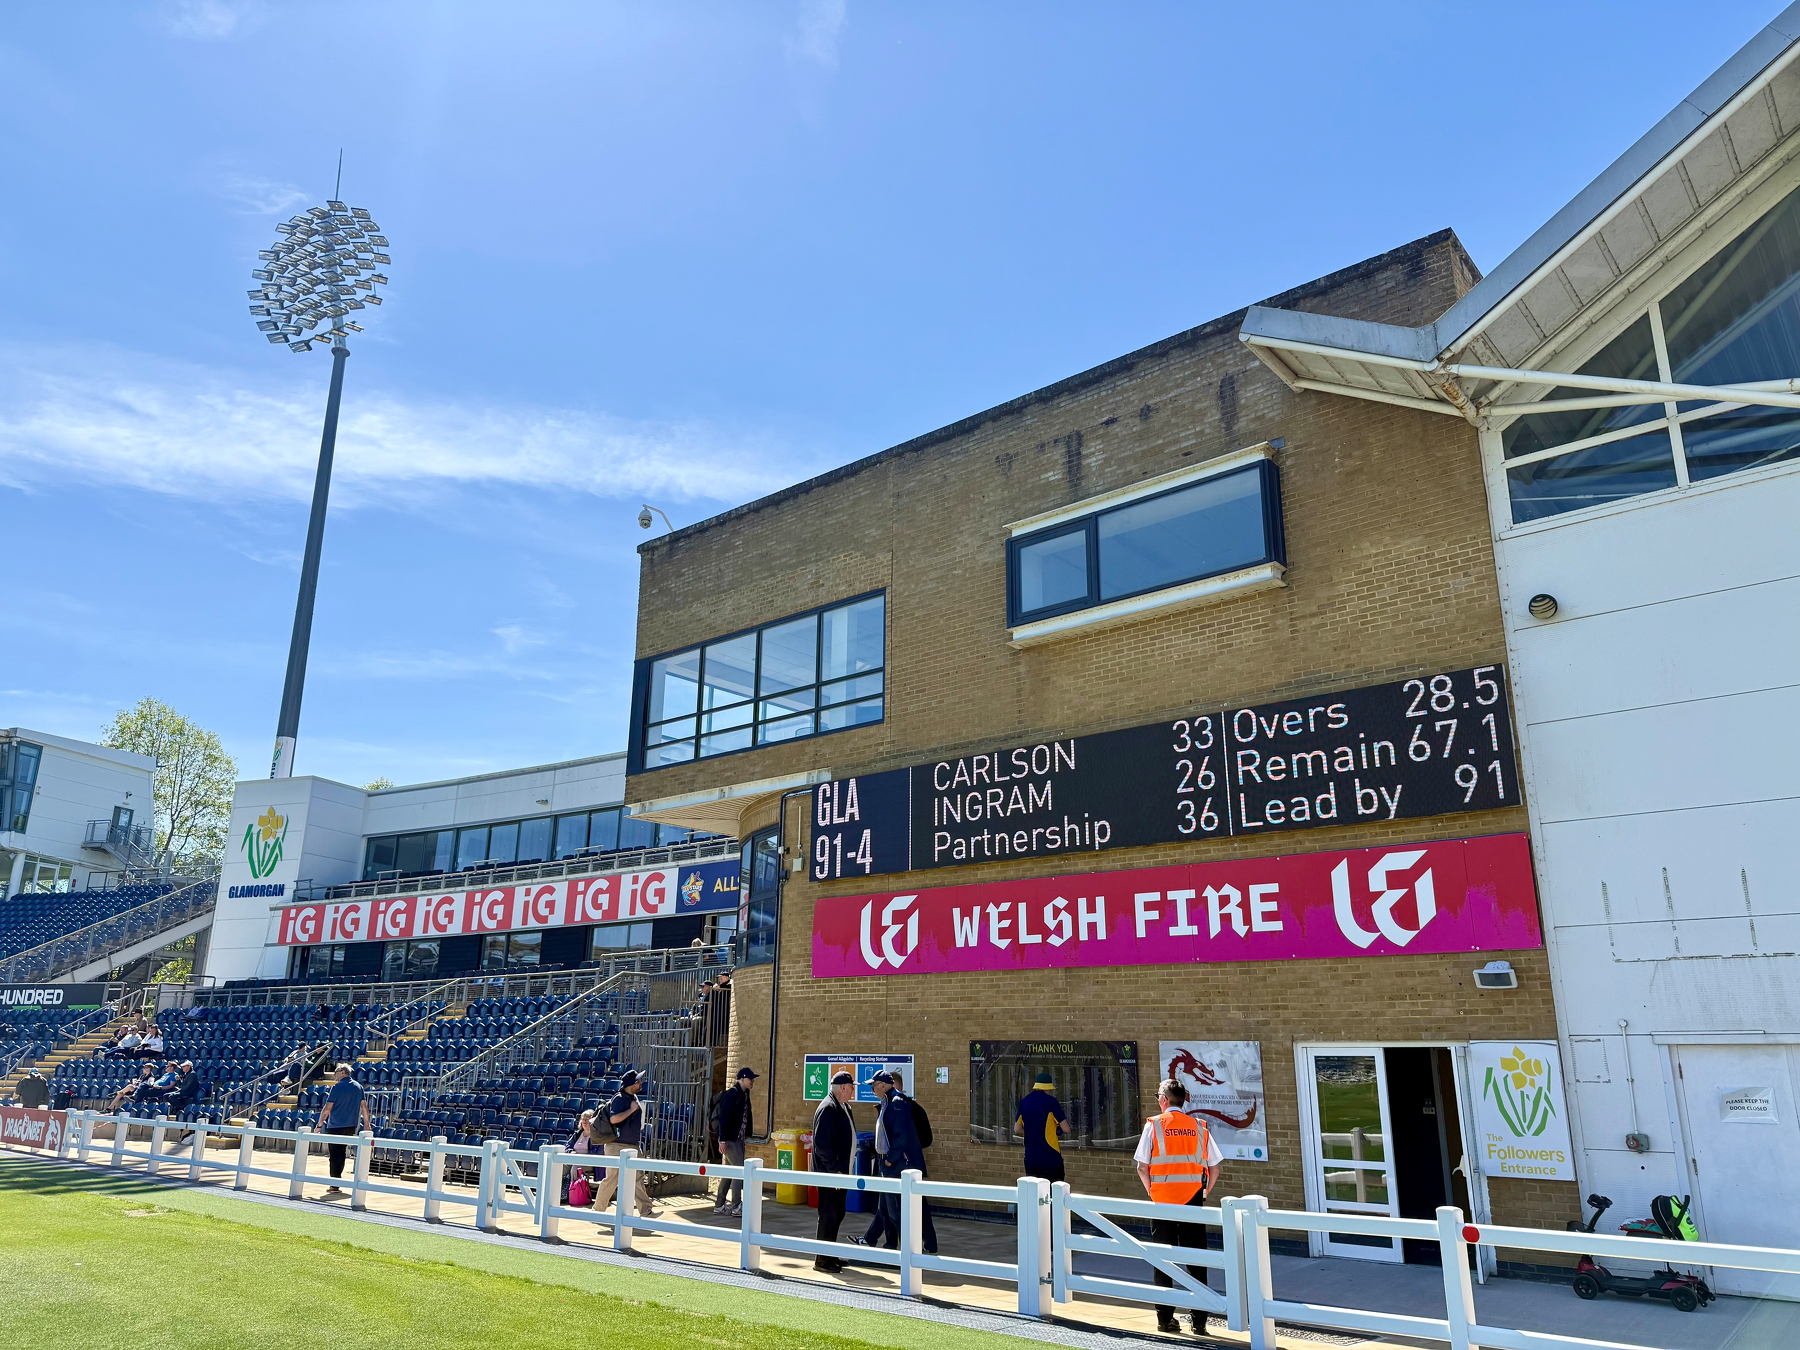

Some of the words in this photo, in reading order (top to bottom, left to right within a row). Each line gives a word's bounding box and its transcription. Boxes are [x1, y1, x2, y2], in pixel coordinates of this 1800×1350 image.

[1233, 703, 1349, 743] Overs
[1402, 666, 1499, 718] 28.5
[1172, 716, 1214, 753] 33
[1237, 732, 1396, 785] Remain
[1407, 713, 1499, 762] 67.1
[933, 739, 1075, 791] CARLSON
[1175, 756, 1216, 794] 26
[817, 778, 860, 827] GLA
[934, 780, 1053, 827] INGRAM
[1240, 782, 1337, 828] Lead
[1355, 778, 1402, 820] by
[1454, 759, 1505, 804] 91
[1177, 797, 1219, 834] 36
[815, 829, 873, 879] 91-4
[934, 812, 1111, 862] Partnership
[228, 883, 285, 899] GLAMORGAN
[952, 896, 1106, 950] WELSH
[1134, 882, 1284, 940] FIRE
[1027, 1043, 1056, 1053] THANK
[1057, 1043, 1074, 1053] YOU
[4, 1113, 46, 1142] DRAGONBET
[1165, 1128, 1196, 1136] STEWARD
[1486, 1133, 1503, 1142] The
[1487, 1143, 1565, 1163] Followers
[1500, 1162, 1556, 1175] Entrance
